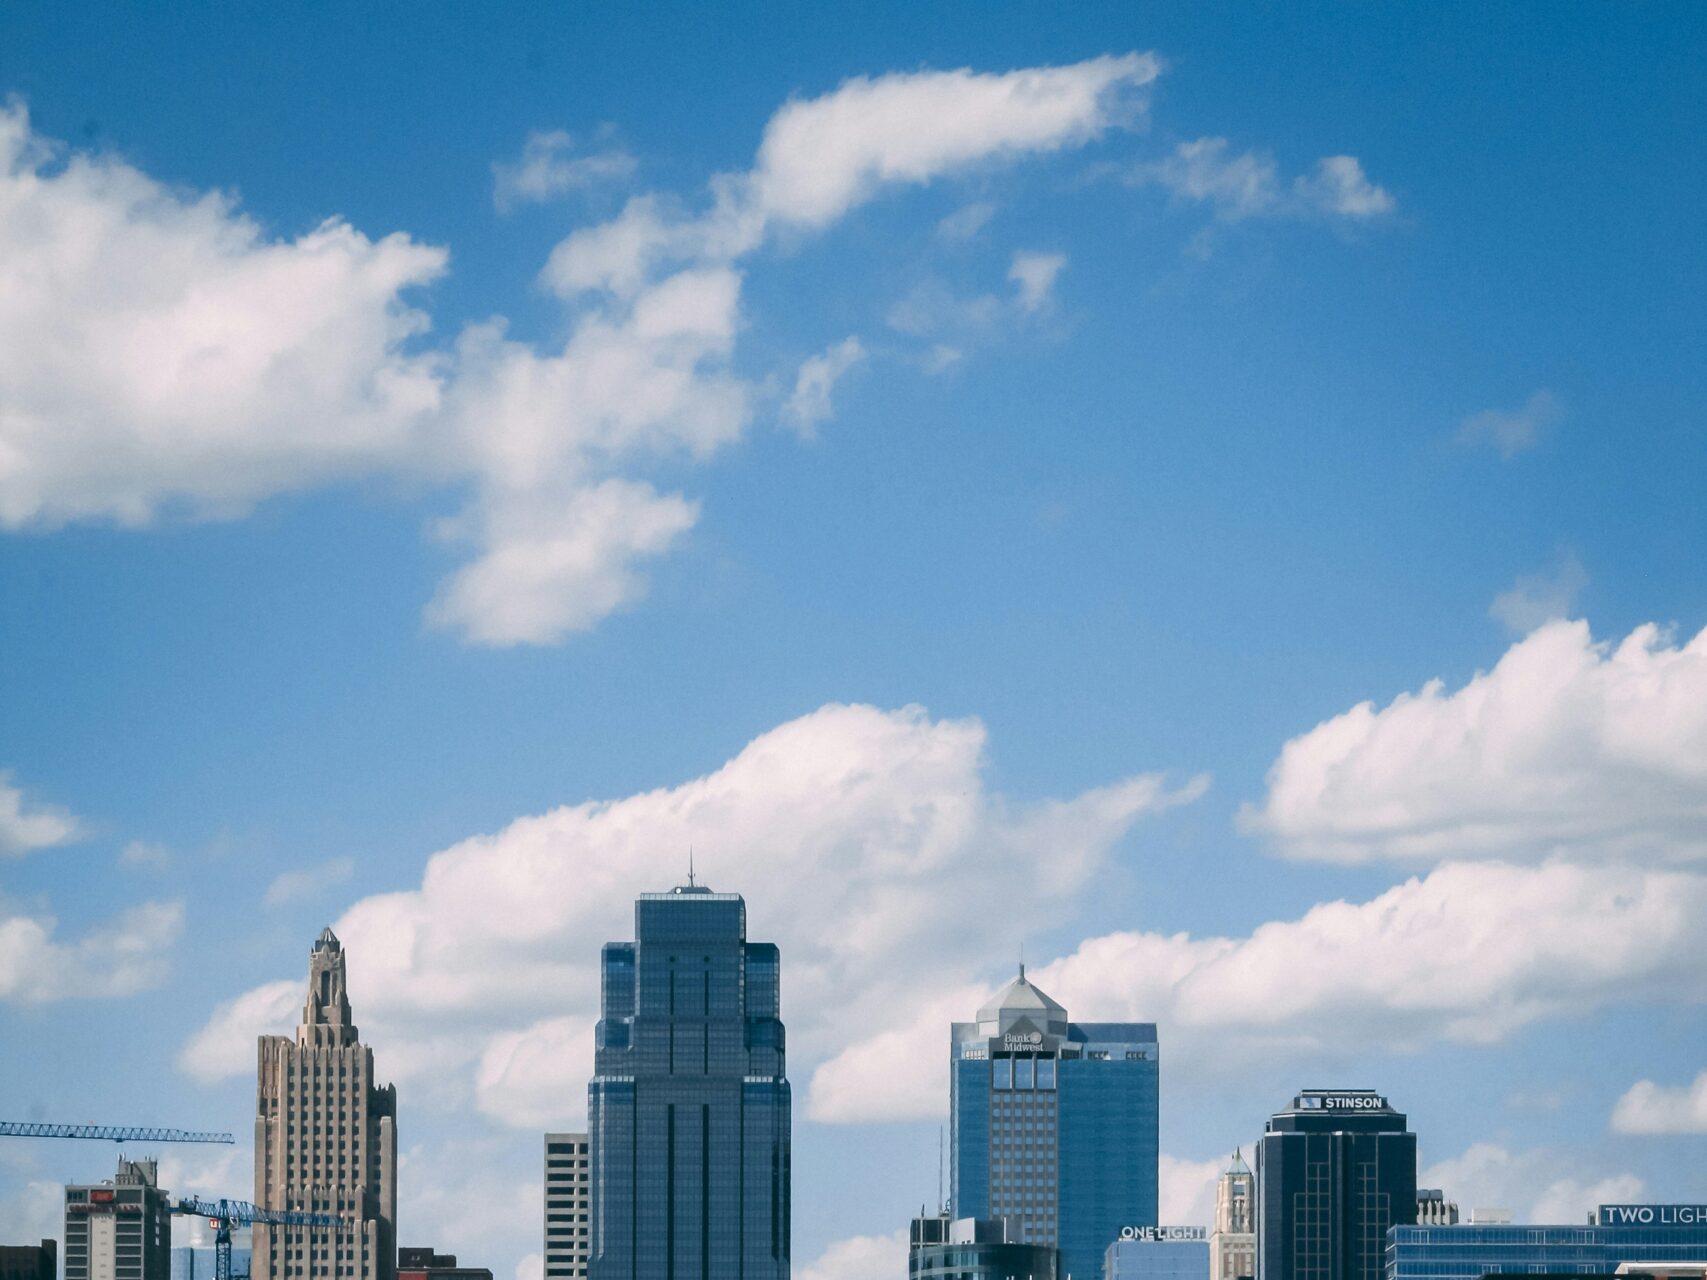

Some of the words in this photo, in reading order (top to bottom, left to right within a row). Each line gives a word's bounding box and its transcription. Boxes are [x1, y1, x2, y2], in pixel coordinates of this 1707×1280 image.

[1004, 1033, 1030, 1043] Bank
[1004, 1042, 1043, 1051] Midwest
[1325, 1098, 1382, 1108] STINSON
[1606, 1207, 1654, 1223] TWO
[1121, 1226, 1154, 1239] ONE
[1156, 1227, 1205, 1239] LIGHT
